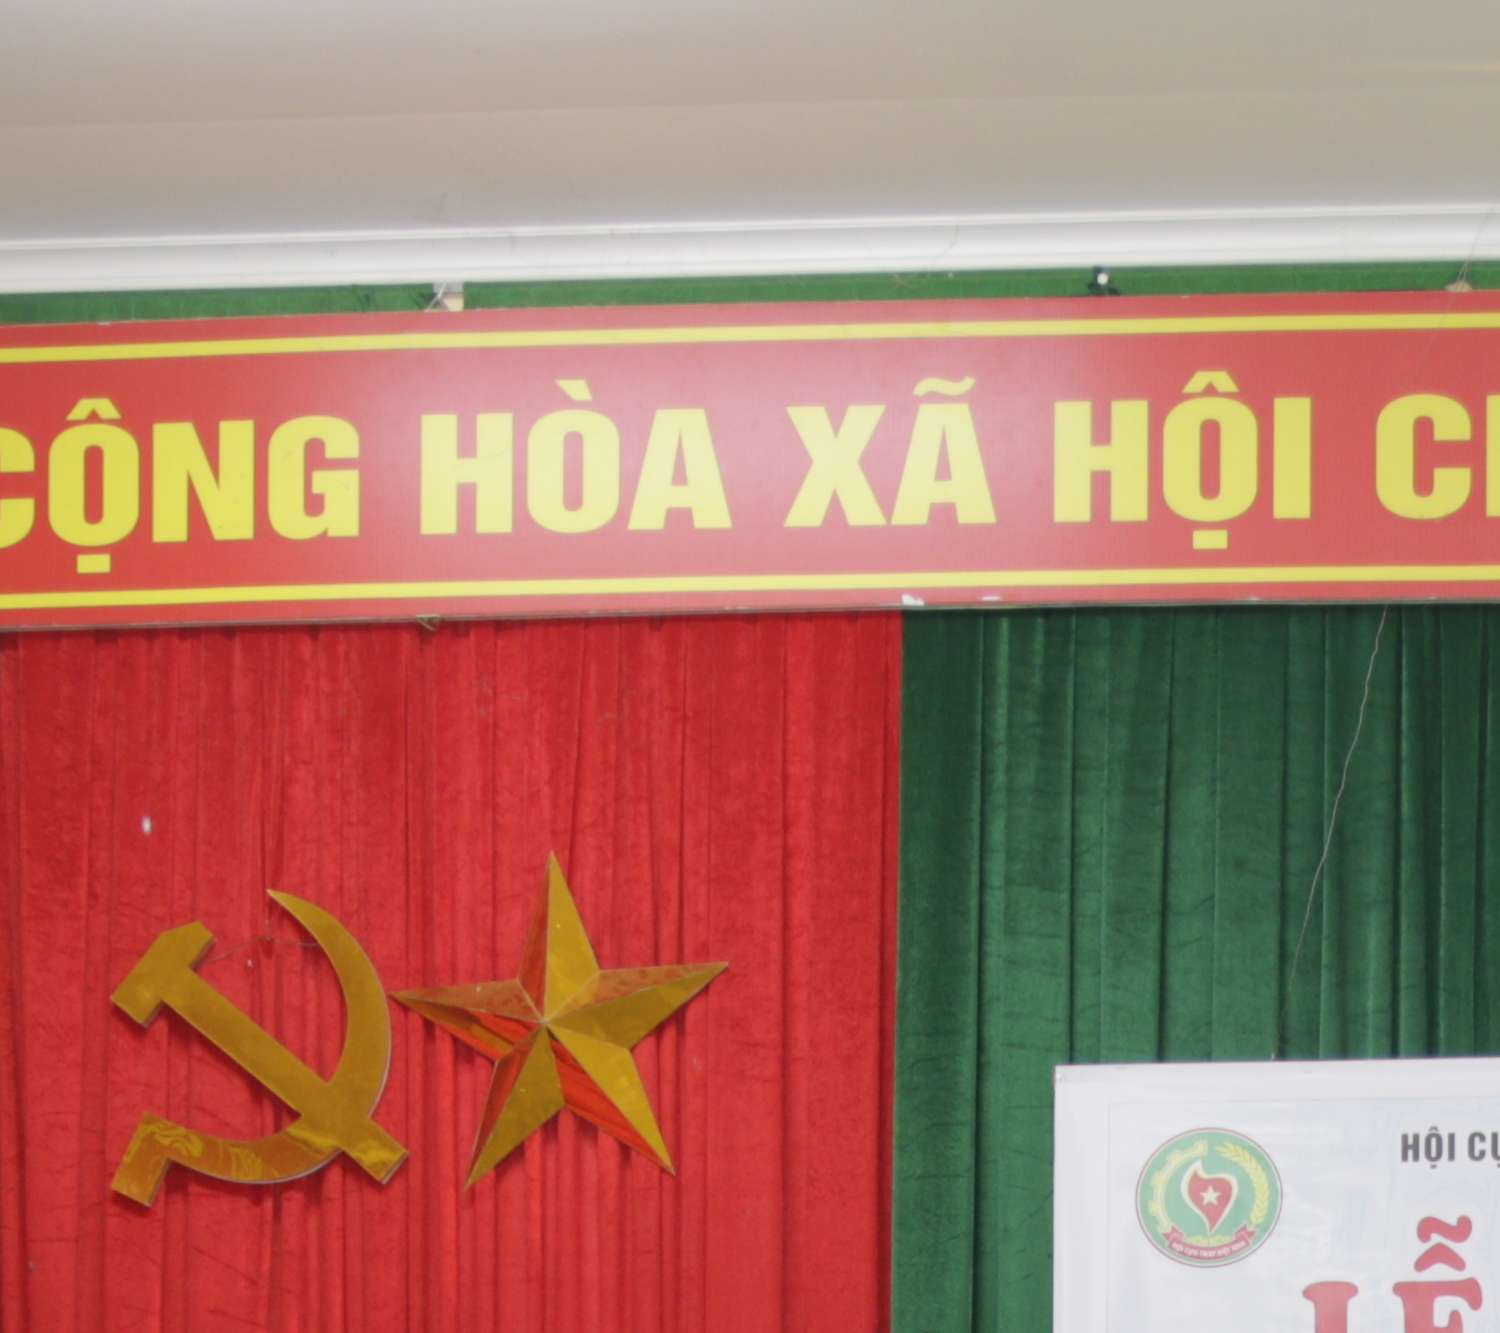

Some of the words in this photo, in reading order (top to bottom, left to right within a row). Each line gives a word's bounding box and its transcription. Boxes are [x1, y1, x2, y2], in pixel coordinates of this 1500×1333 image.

[420, 379, 732, 535] HÒA
[783, 376, 997, 527] XÃ
[1052, 370, 1312, 550] HỘI
[1401, 1127, 1456, 1168] HỘI
